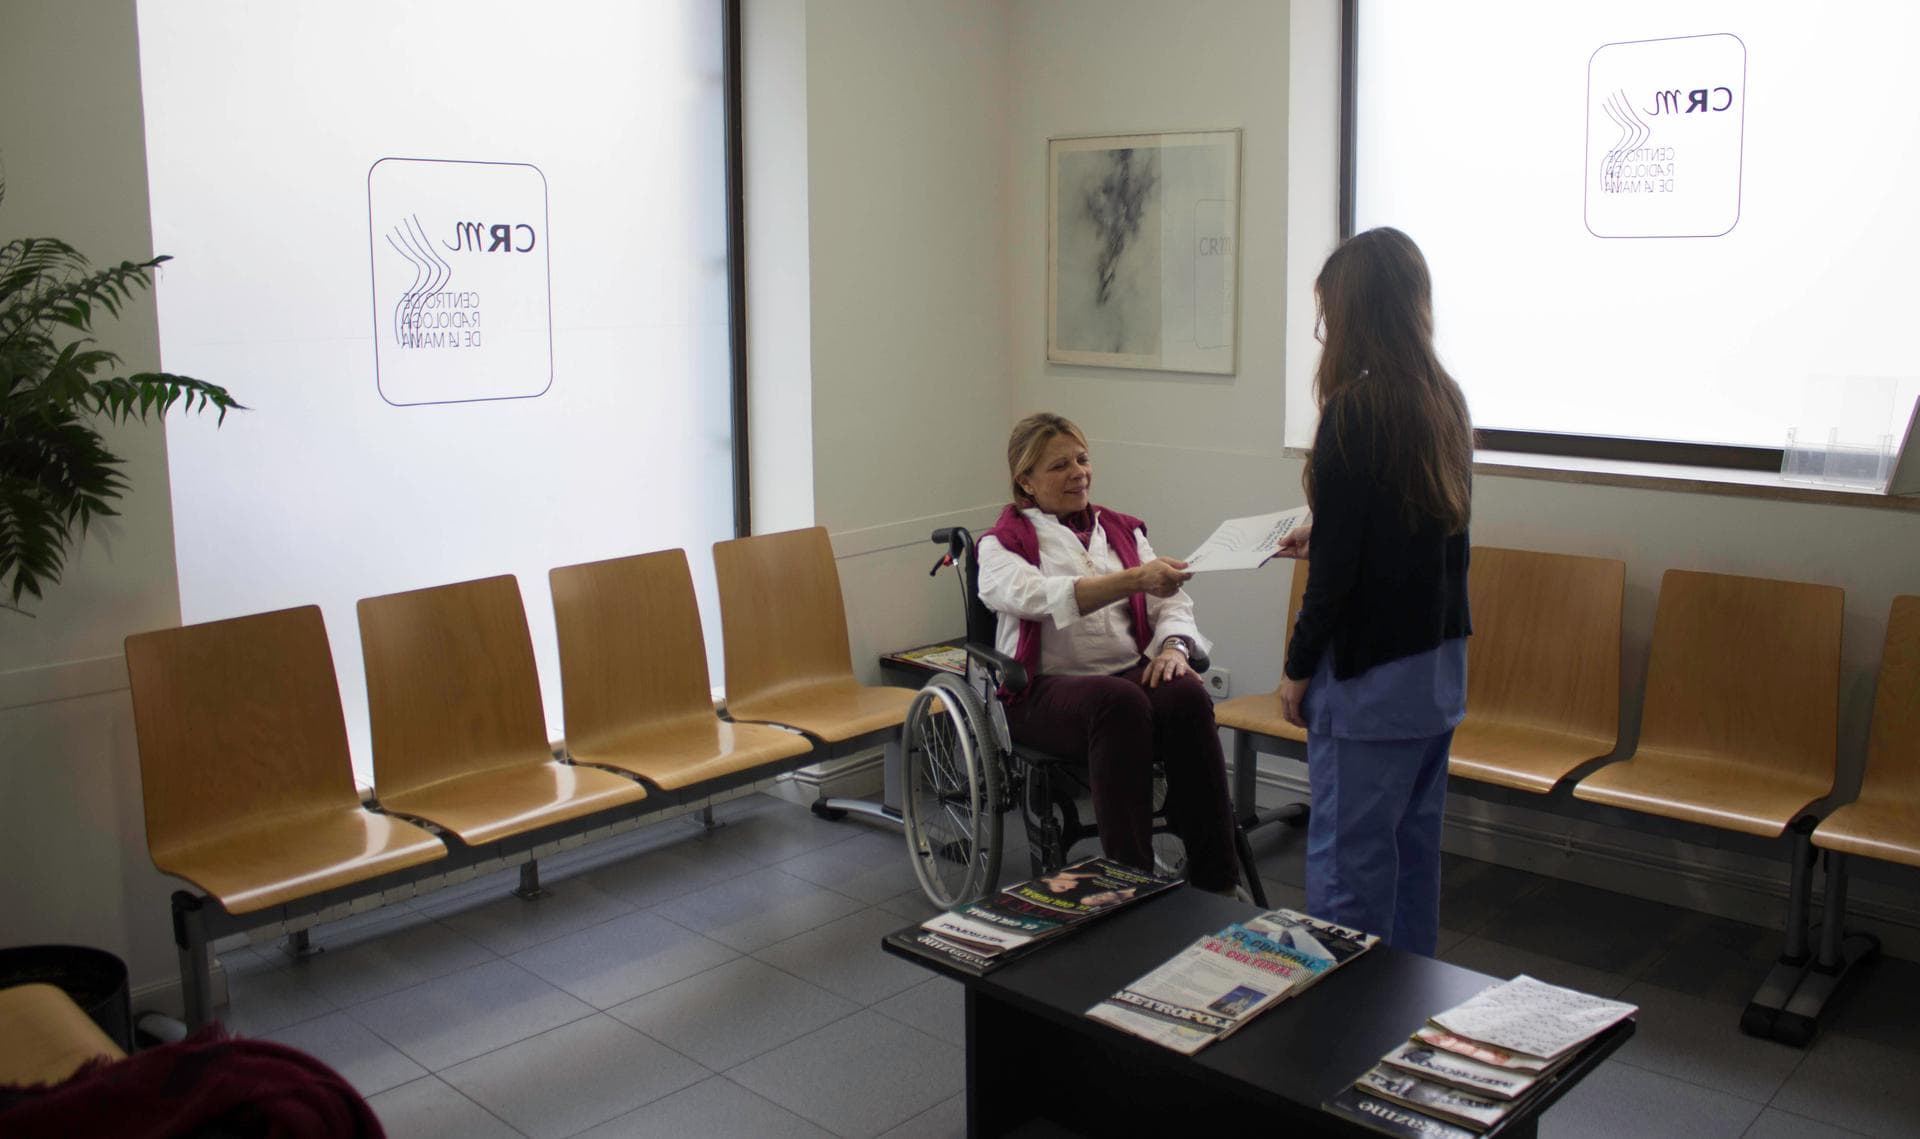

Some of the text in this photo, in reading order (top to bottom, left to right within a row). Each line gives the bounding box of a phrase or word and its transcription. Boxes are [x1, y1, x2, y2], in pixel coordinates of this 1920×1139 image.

[1225, 950, 1292, 977] CULTURAL
[1250, 939, 1314, 968] CULTURAL
[1112, 990, 1236, 1029] METROPOLI
